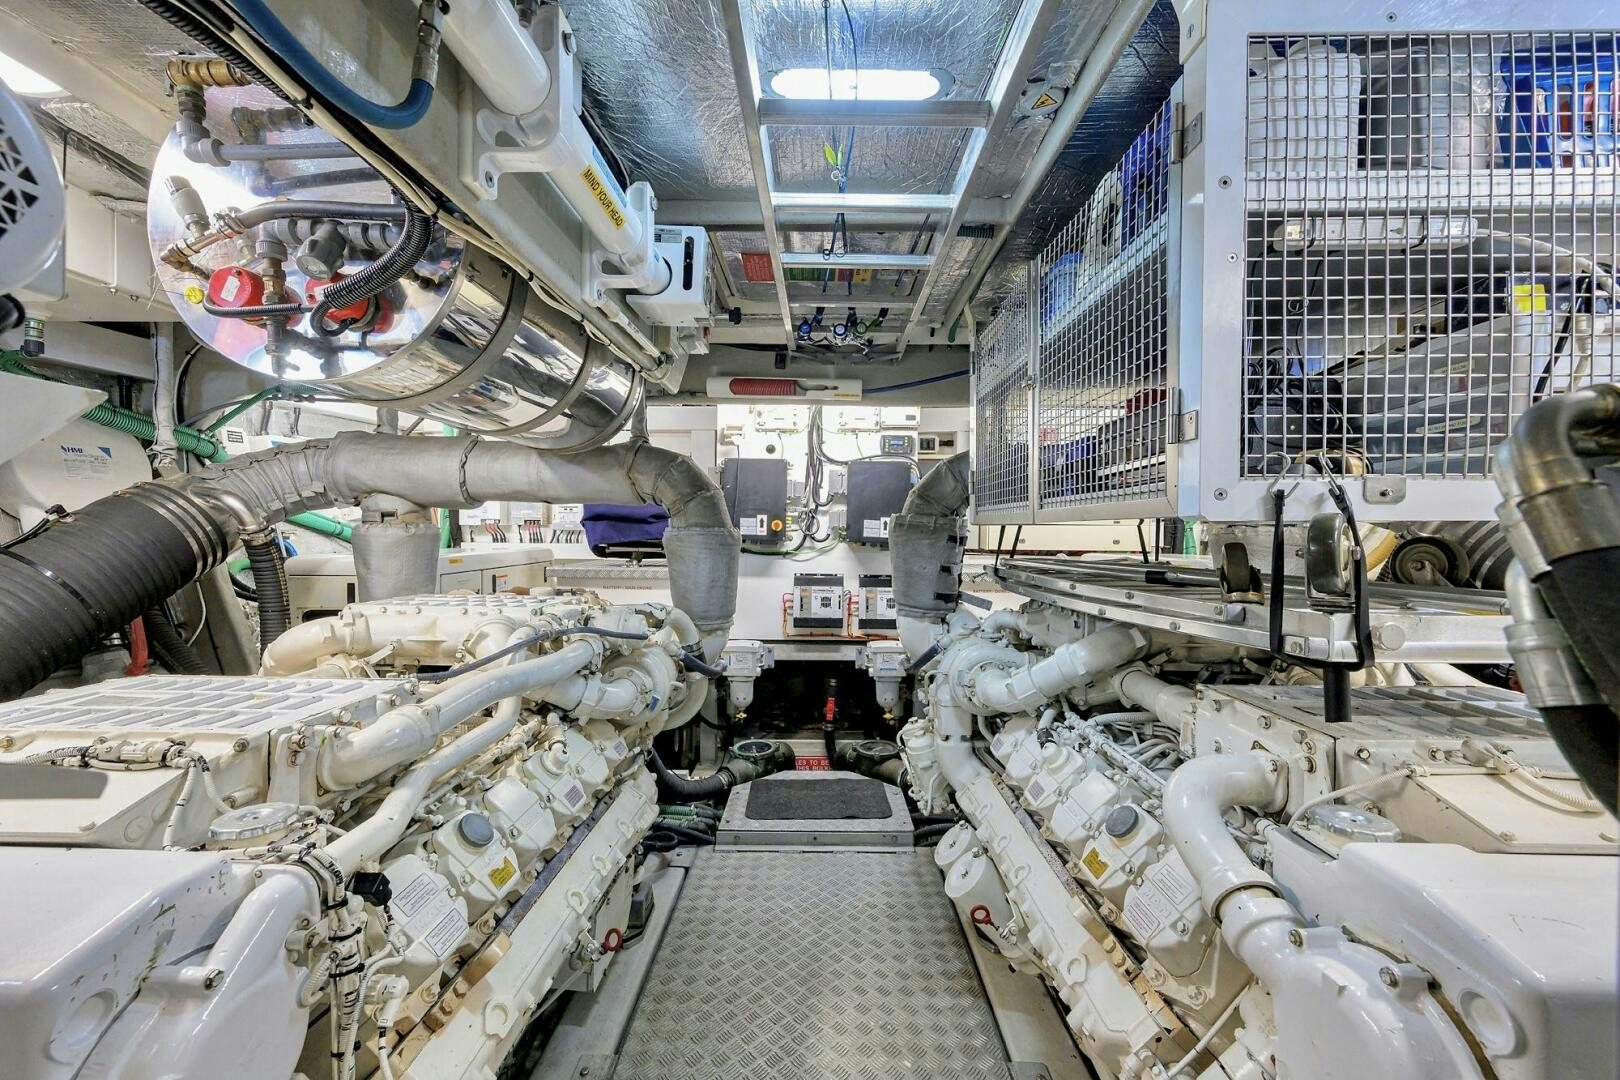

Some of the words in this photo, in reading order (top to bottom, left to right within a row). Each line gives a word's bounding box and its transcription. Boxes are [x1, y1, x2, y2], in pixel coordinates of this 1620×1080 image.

[583, 169, 600, 191] MIND
[597, 188, 613, 210] YOUR
[608, 207, 623, 227] HEAD
